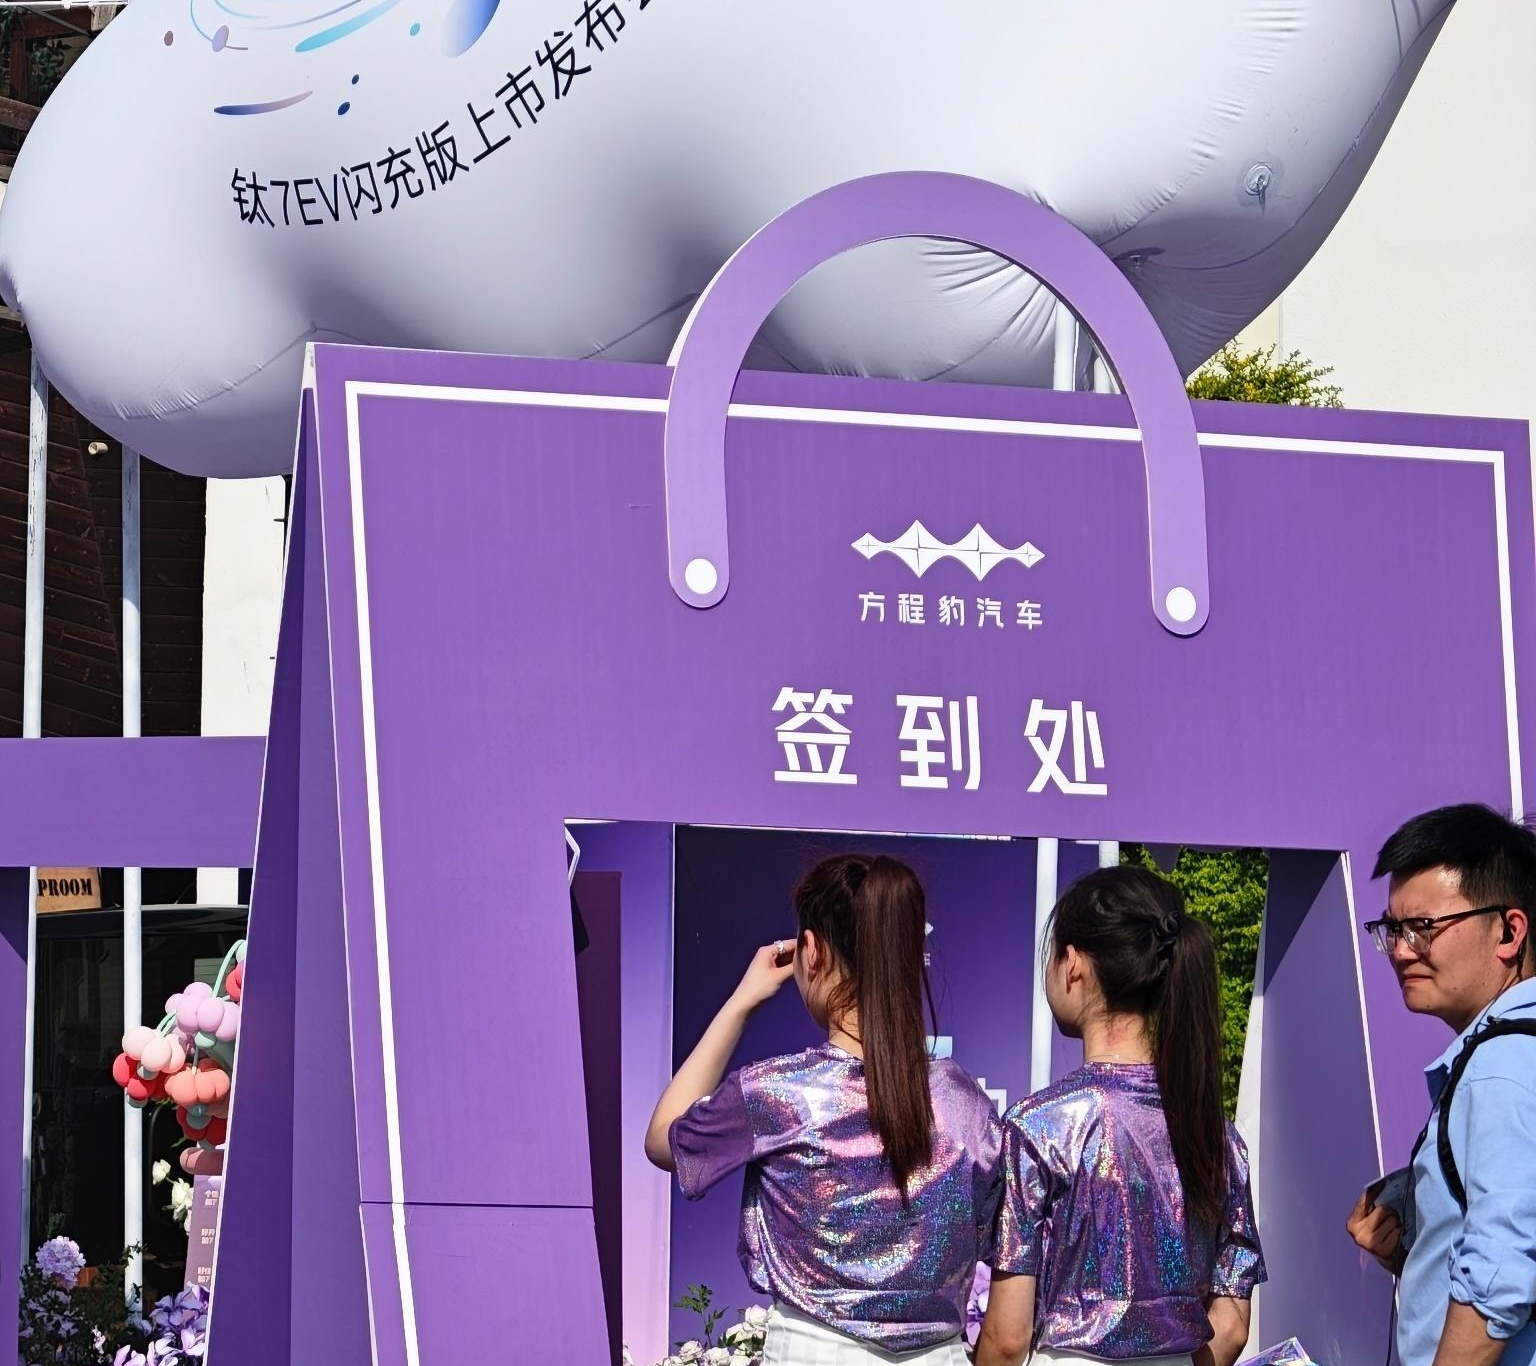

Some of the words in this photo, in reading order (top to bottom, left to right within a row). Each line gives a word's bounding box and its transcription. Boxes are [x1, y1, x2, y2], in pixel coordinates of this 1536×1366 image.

[858, 591, 1044, 630] 方程豹汽车
[771, 686, 1109, 797] 签到处
[37, 878, 93, 897] PROOM
